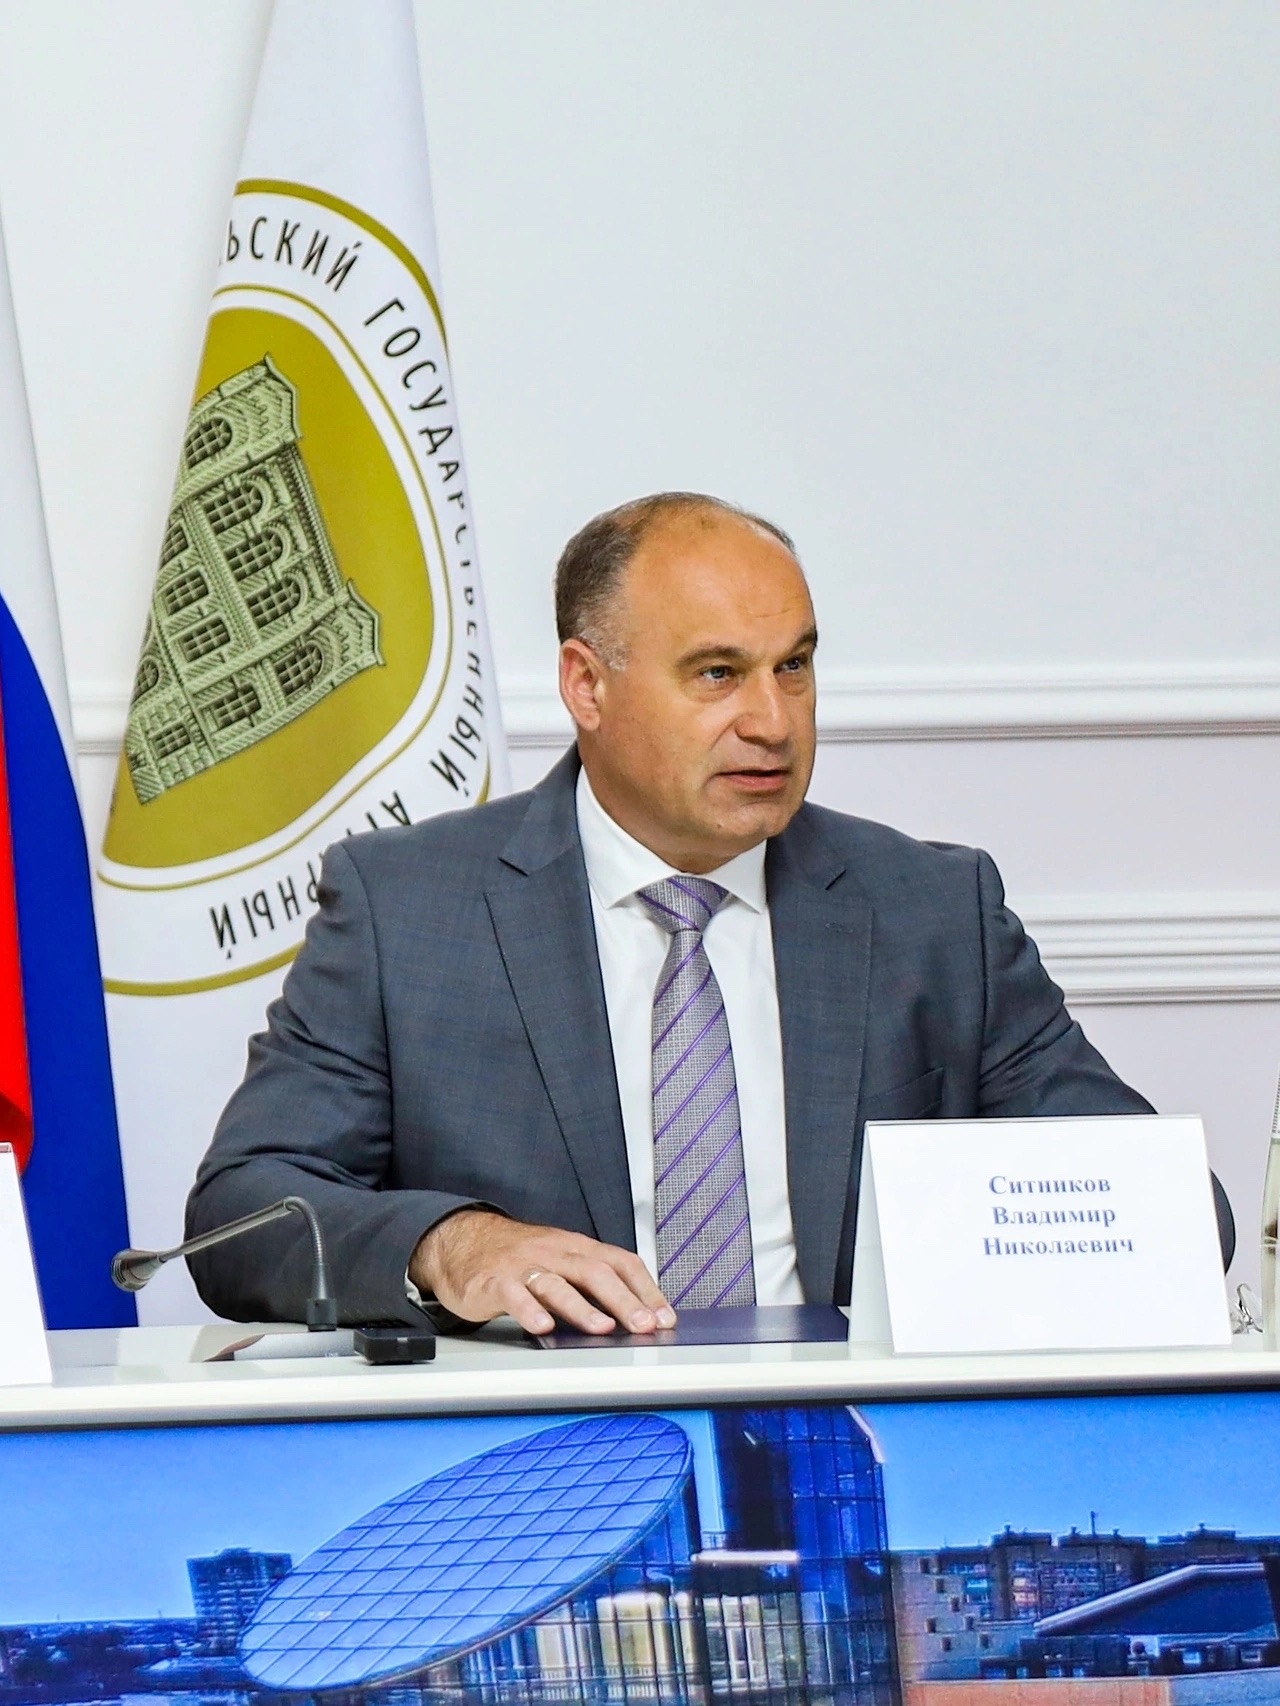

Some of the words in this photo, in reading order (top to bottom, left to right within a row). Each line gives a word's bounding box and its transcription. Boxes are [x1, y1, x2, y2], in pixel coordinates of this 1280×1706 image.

[219, 214, 363, 293] ЬСКИЙ
[988, 1175, 1111, 1195] Ситников
[992, 1206, 1116, 1228] Владимир
[982, 1236, 1134, 1256] Николаевич
